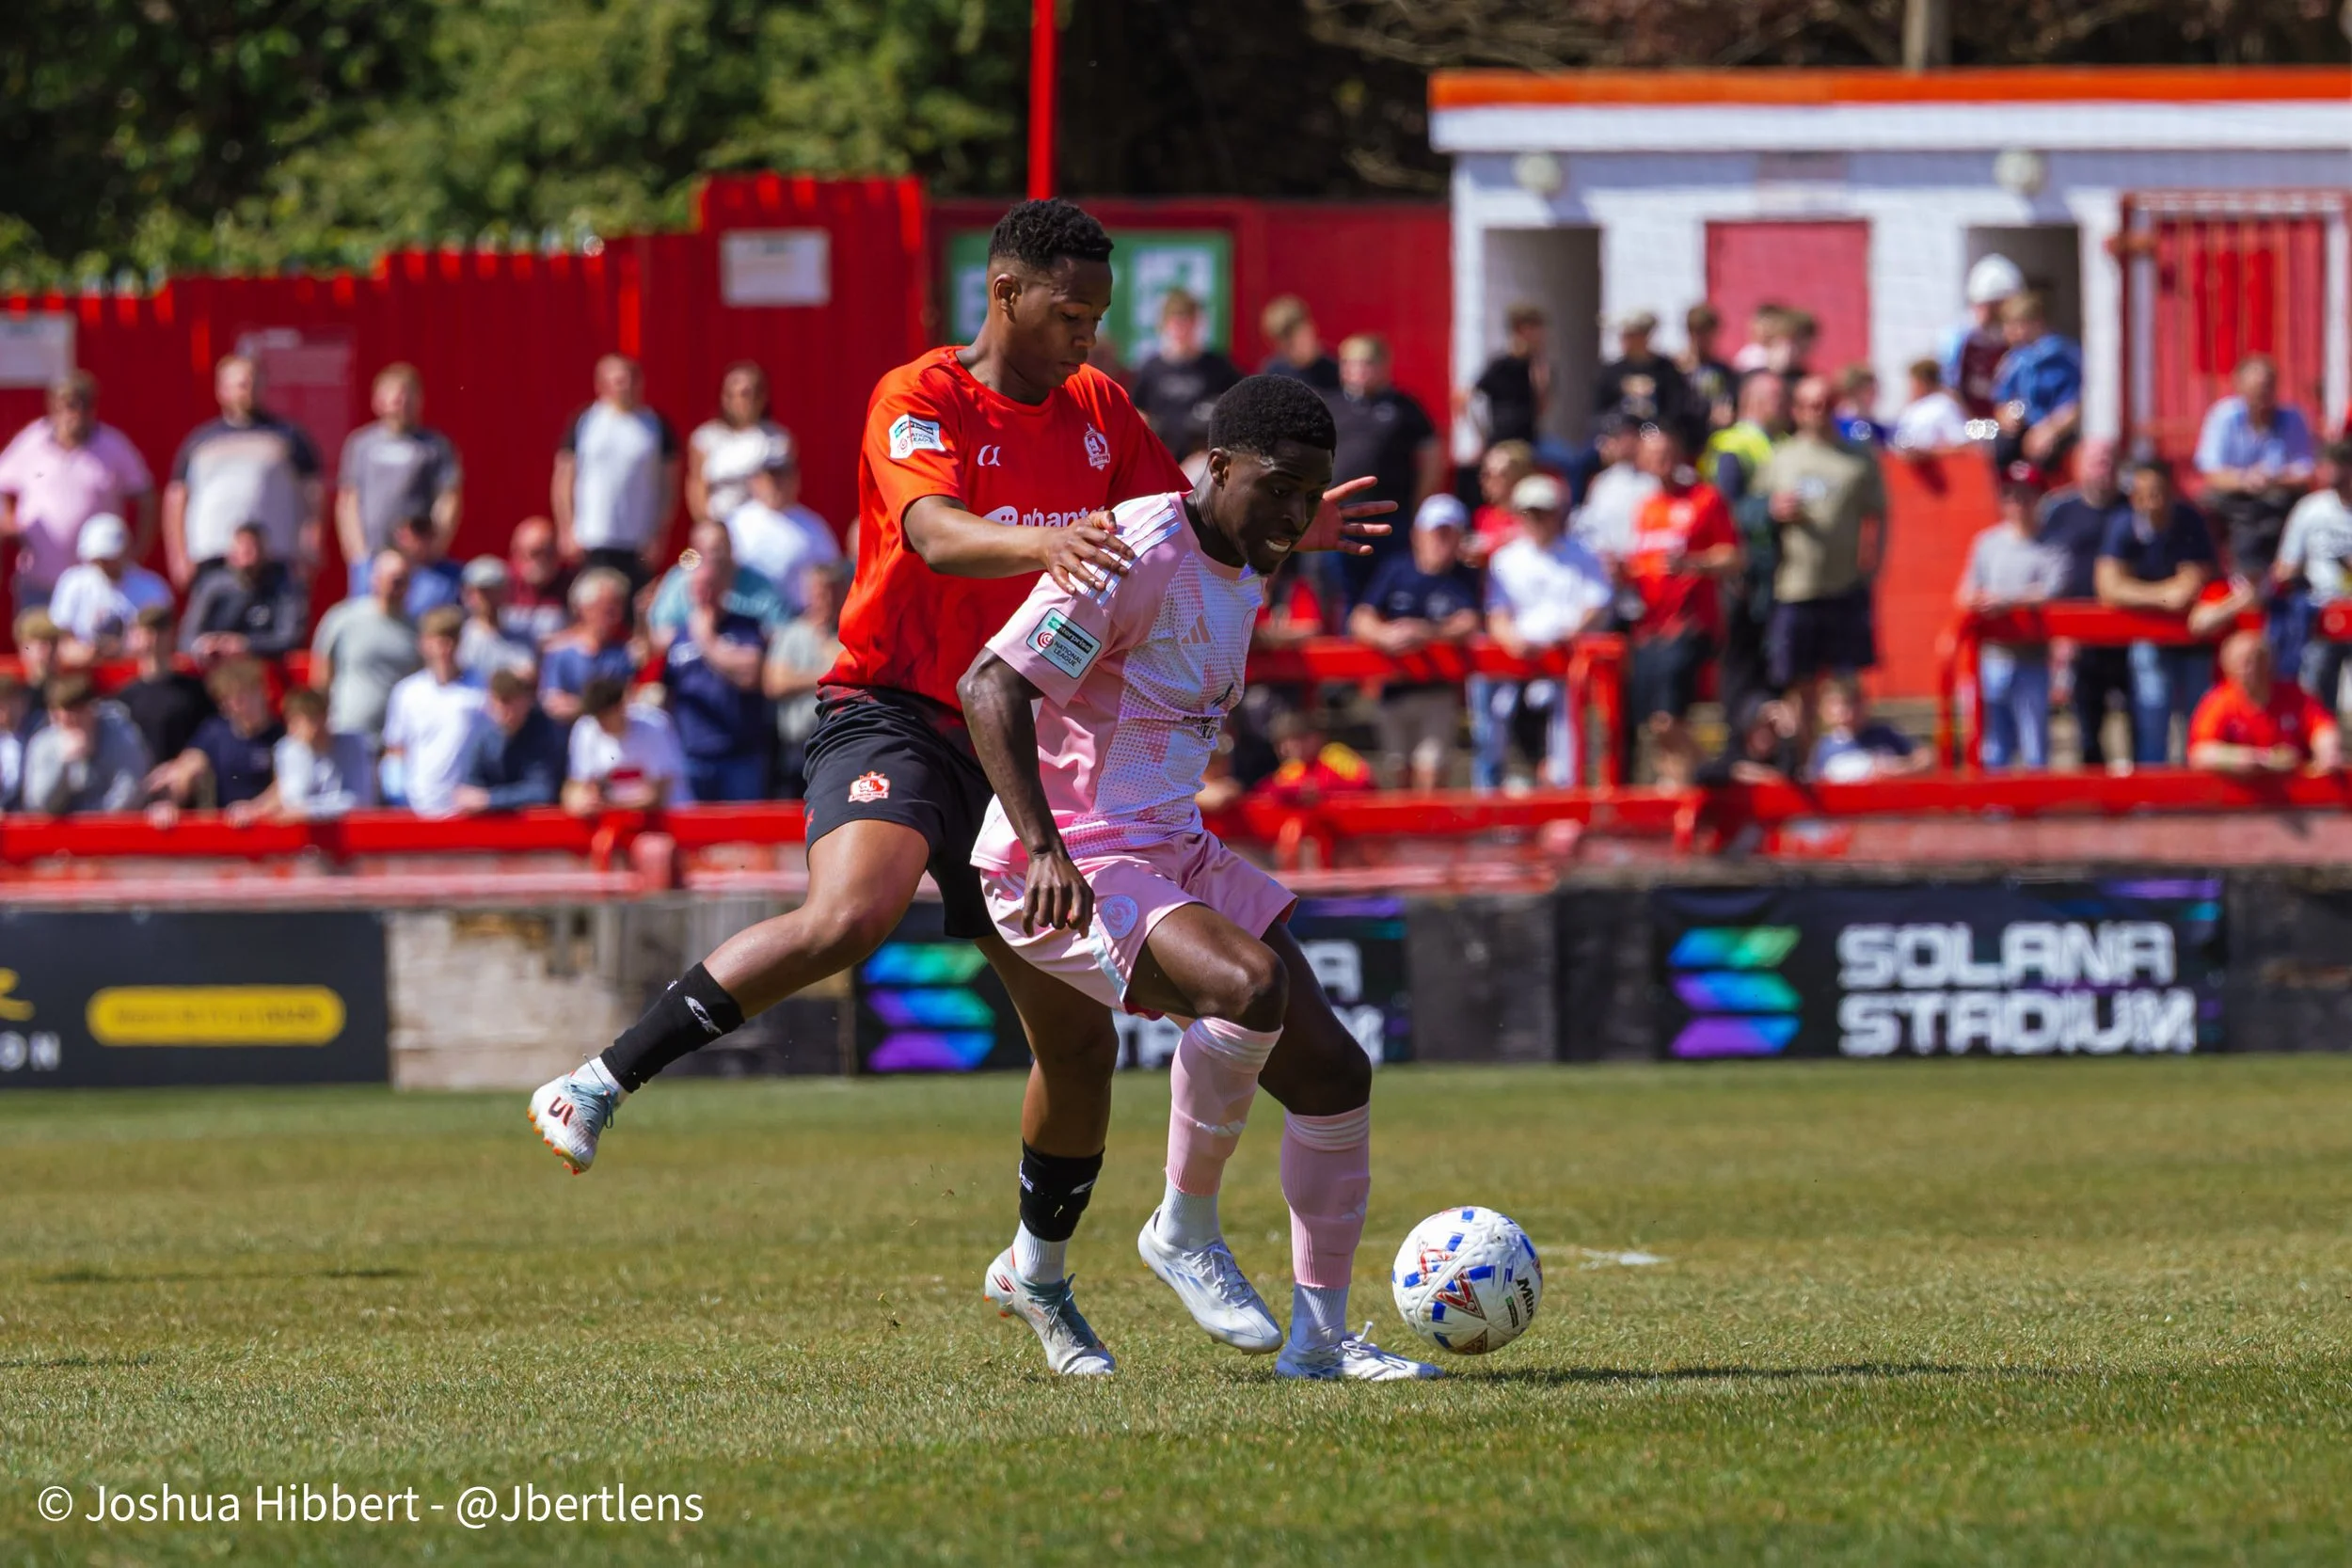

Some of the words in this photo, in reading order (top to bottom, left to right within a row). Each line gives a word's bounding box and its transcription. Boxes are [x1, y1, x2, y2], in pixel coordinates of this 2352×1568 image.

[1053, 646, 1078, 667] LEAGUE
[1054, 640, 1084, 664] NATIONAL
[1836, 921, 2177, 989] SOLANA
[1836, 988, 2199, 1056] STADIUM
